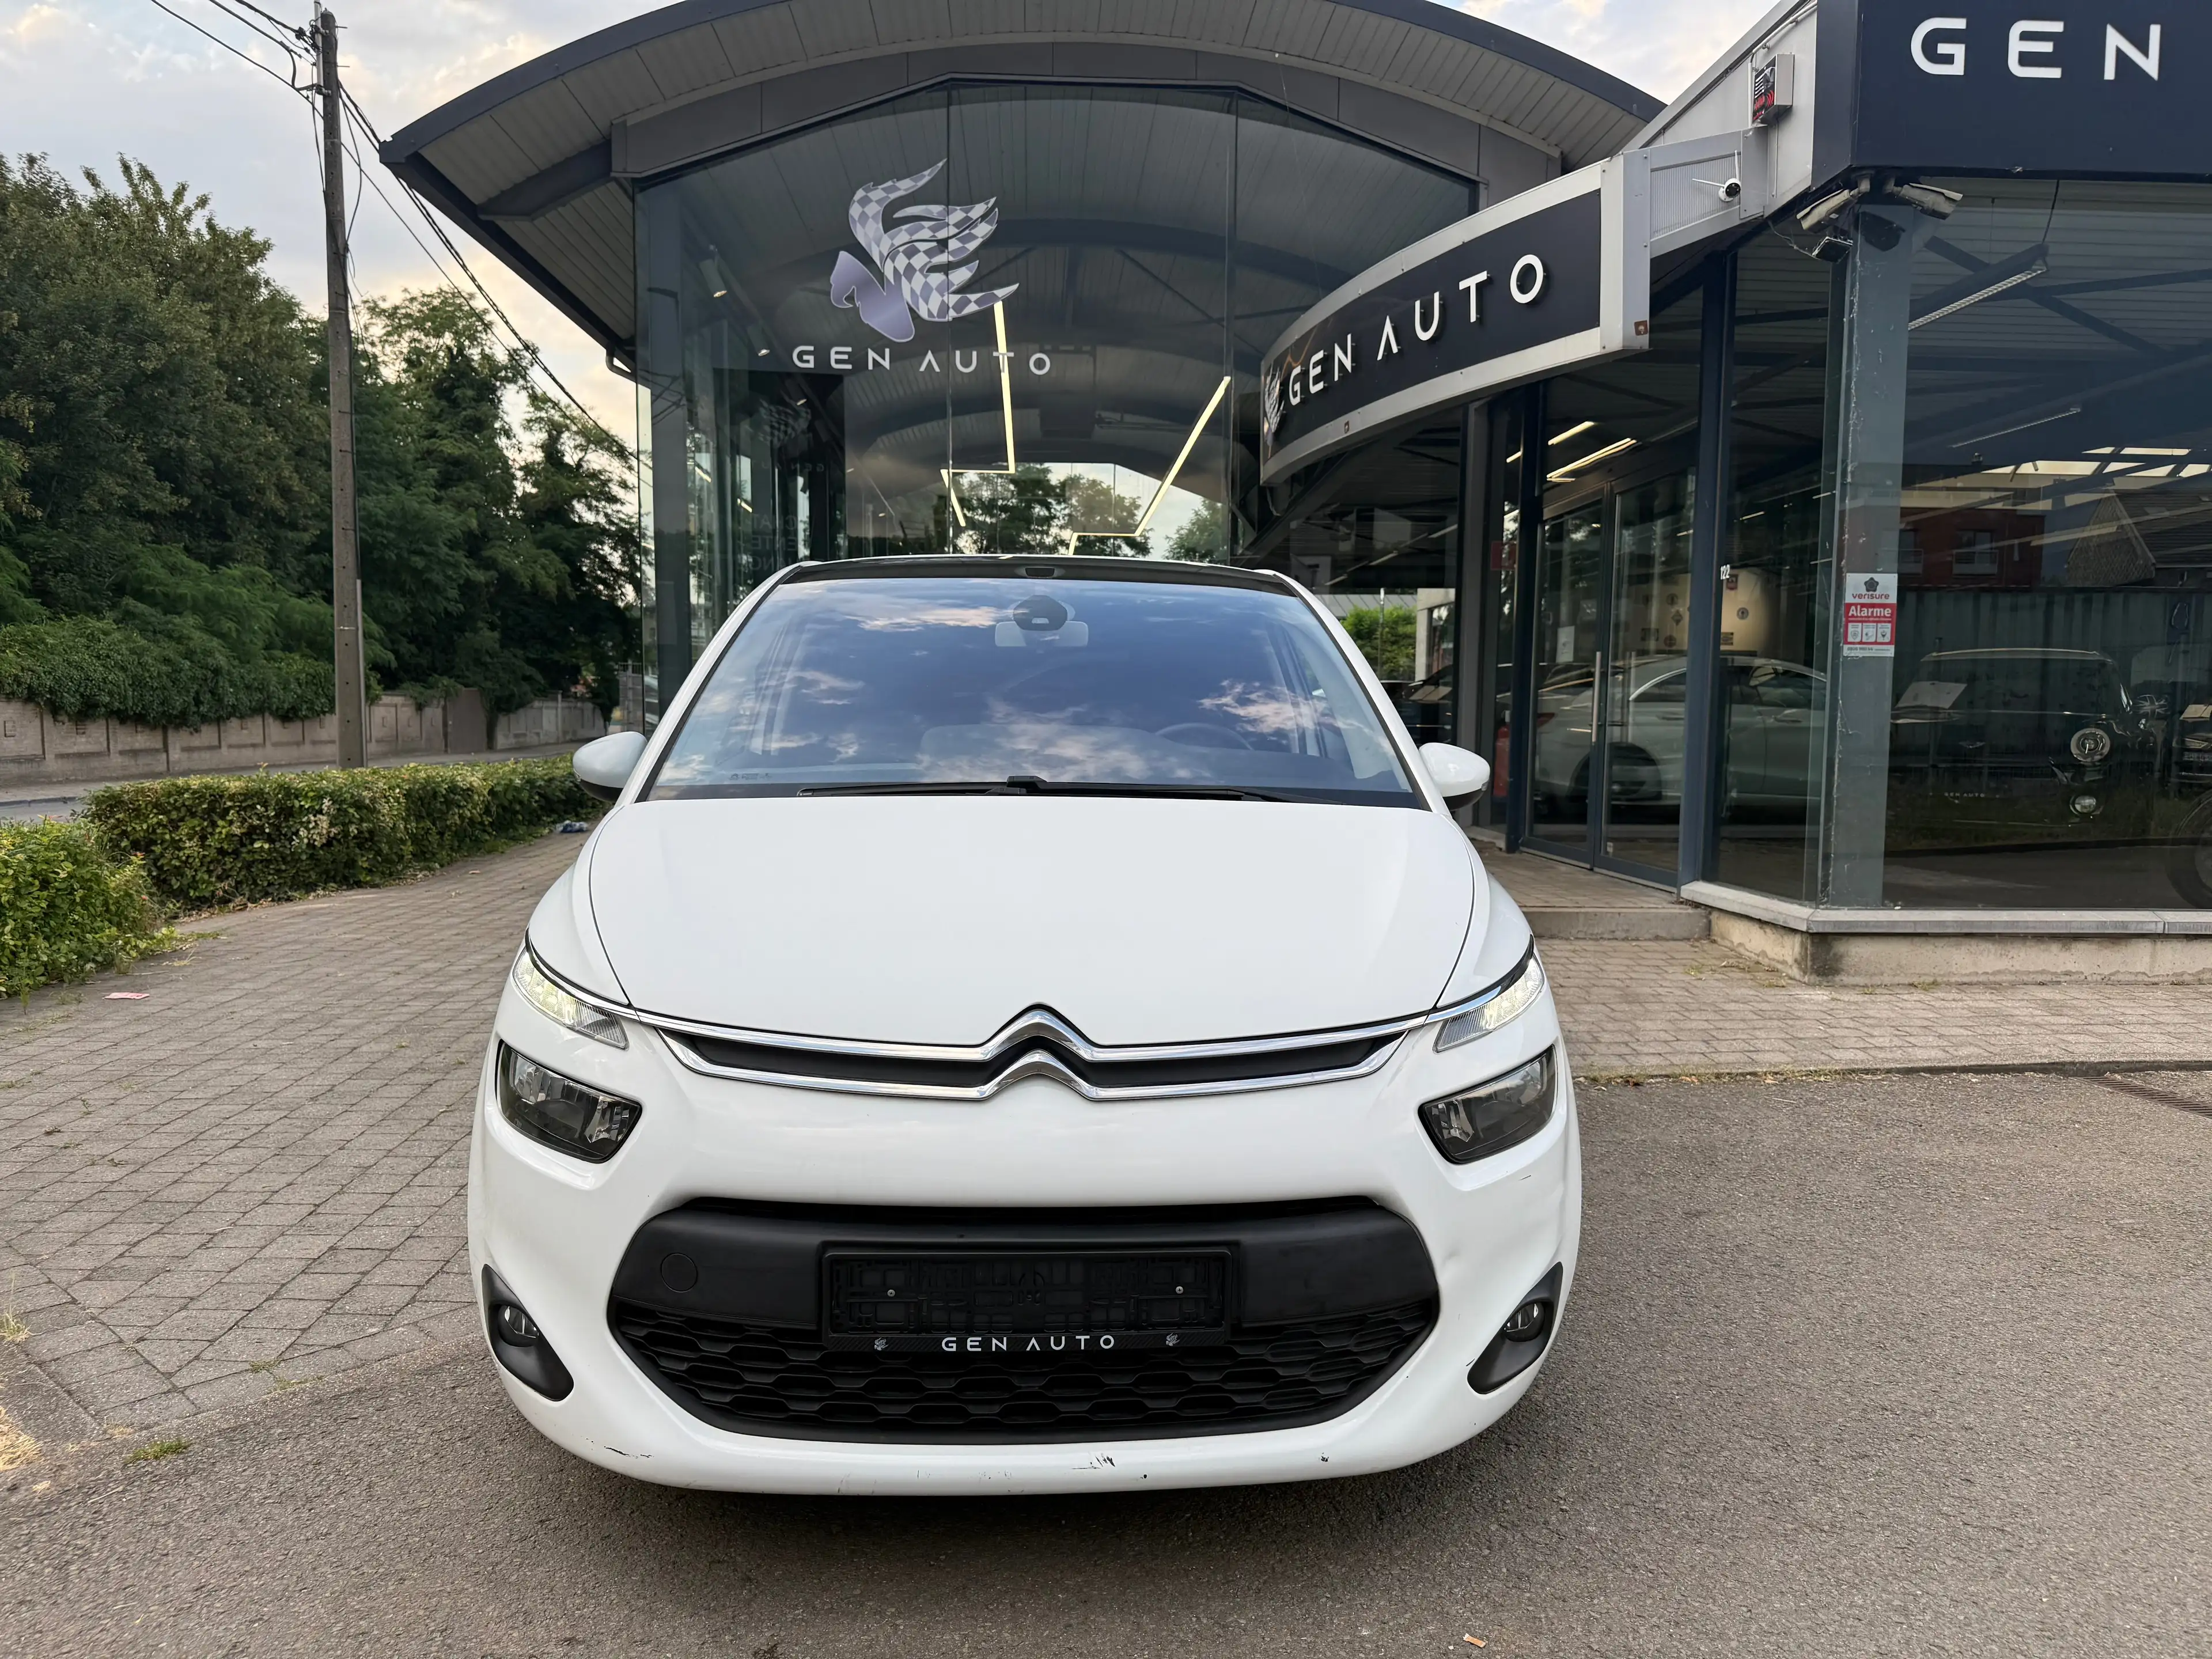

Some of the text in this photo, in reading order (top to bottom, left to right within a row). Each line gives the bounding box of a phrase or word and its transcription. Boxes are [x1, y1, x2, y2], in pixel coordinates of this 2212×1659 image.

[1910, 17, 2161, 81] GEN
[1289, 254, 1544, 406] GEN AUTO
[792, 346, 1051, 376] GEN AUTO
[1720, 564, 1730, 580] 122
[1848, 605, 1892, 617] Alarme
[941, 1334, 1115, 1352] GEN AUTO
